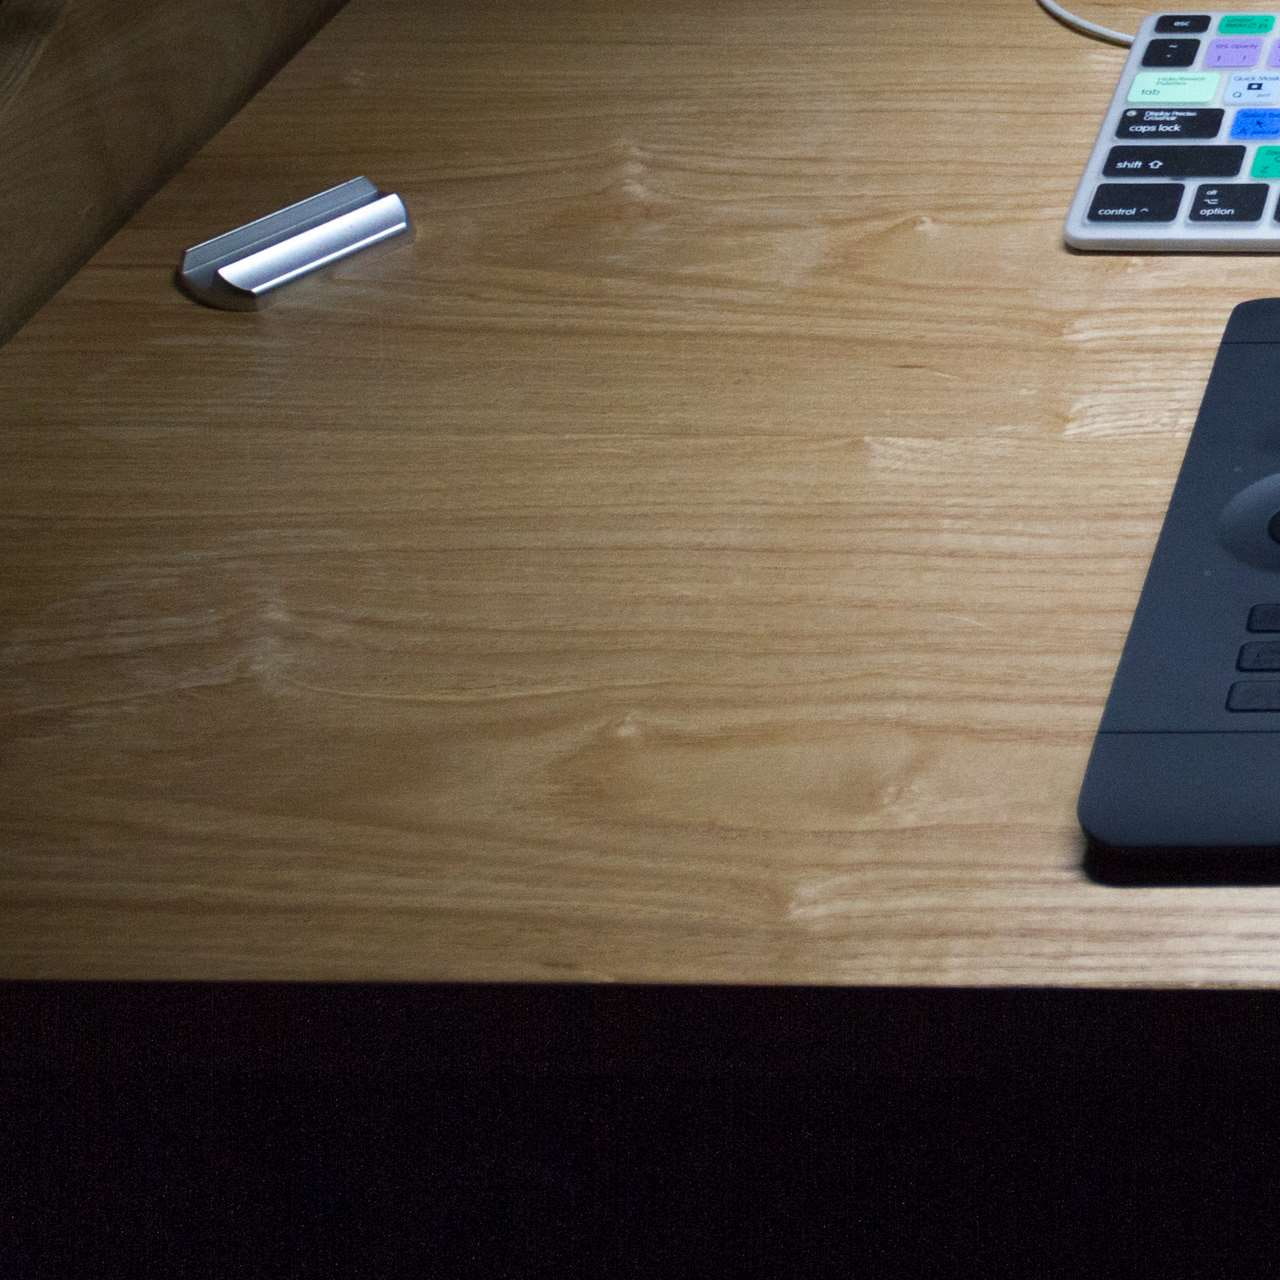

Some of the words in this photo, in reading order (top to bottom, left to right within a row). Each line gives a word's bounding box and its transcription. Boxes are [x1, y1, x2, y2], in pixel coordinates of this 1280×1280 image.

[1129, 124, 1157, 133] caps
[1158, 124, 1181, 132] lock
[1116, 161, 1142, 169] shift
[1098, 208, 1136, 216] control
[1200, 207, 1234, 216] option
